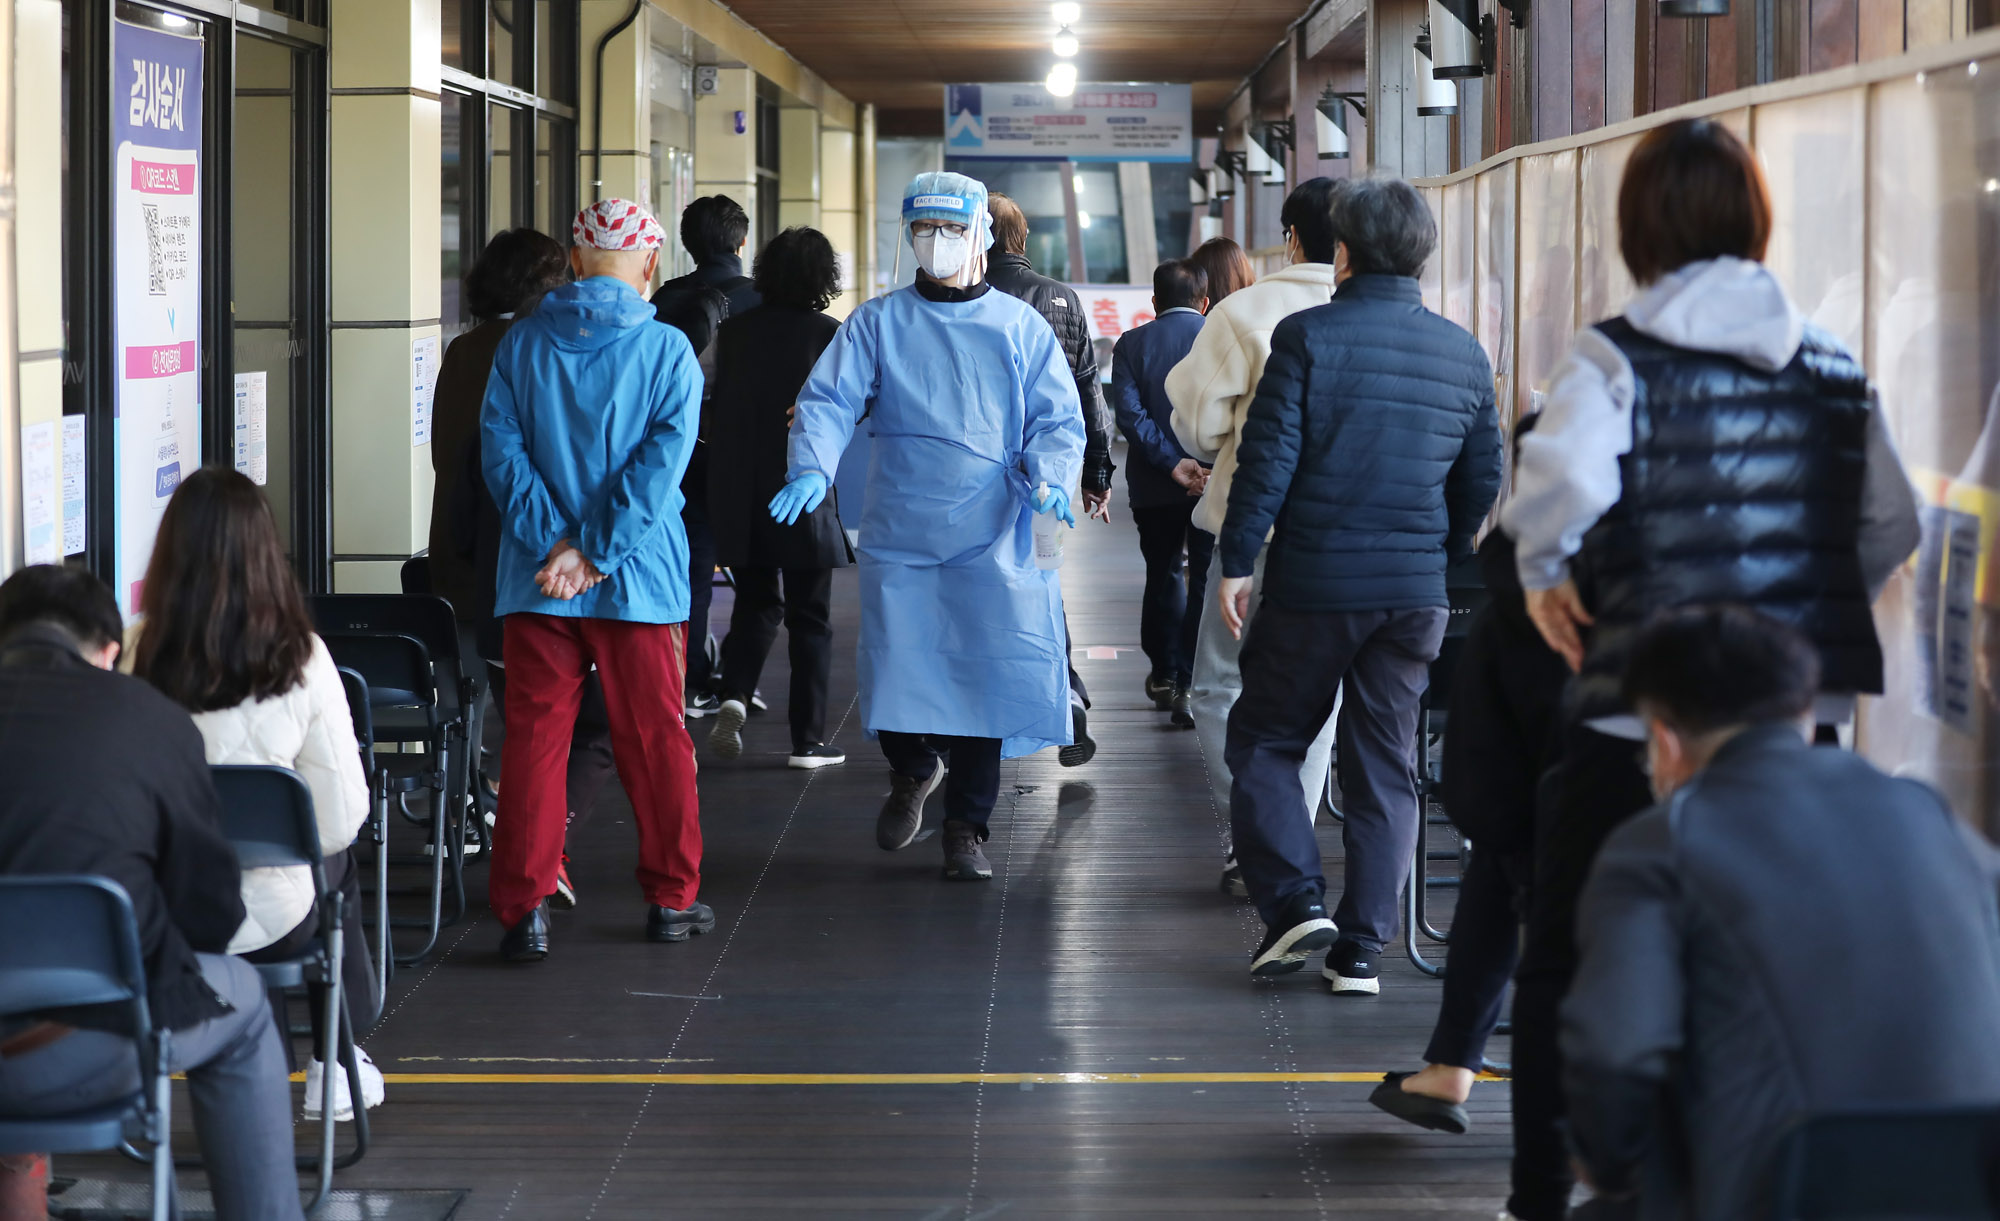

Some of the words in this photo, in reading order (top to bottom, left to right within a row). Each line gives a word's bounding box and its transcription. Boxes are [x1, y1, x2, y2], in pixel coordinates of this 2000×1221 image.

[129, 58, 186, 132] 검사순서
[915, 196, 933, 206] FACE
[934, 196, 960, 206] SHIELD
